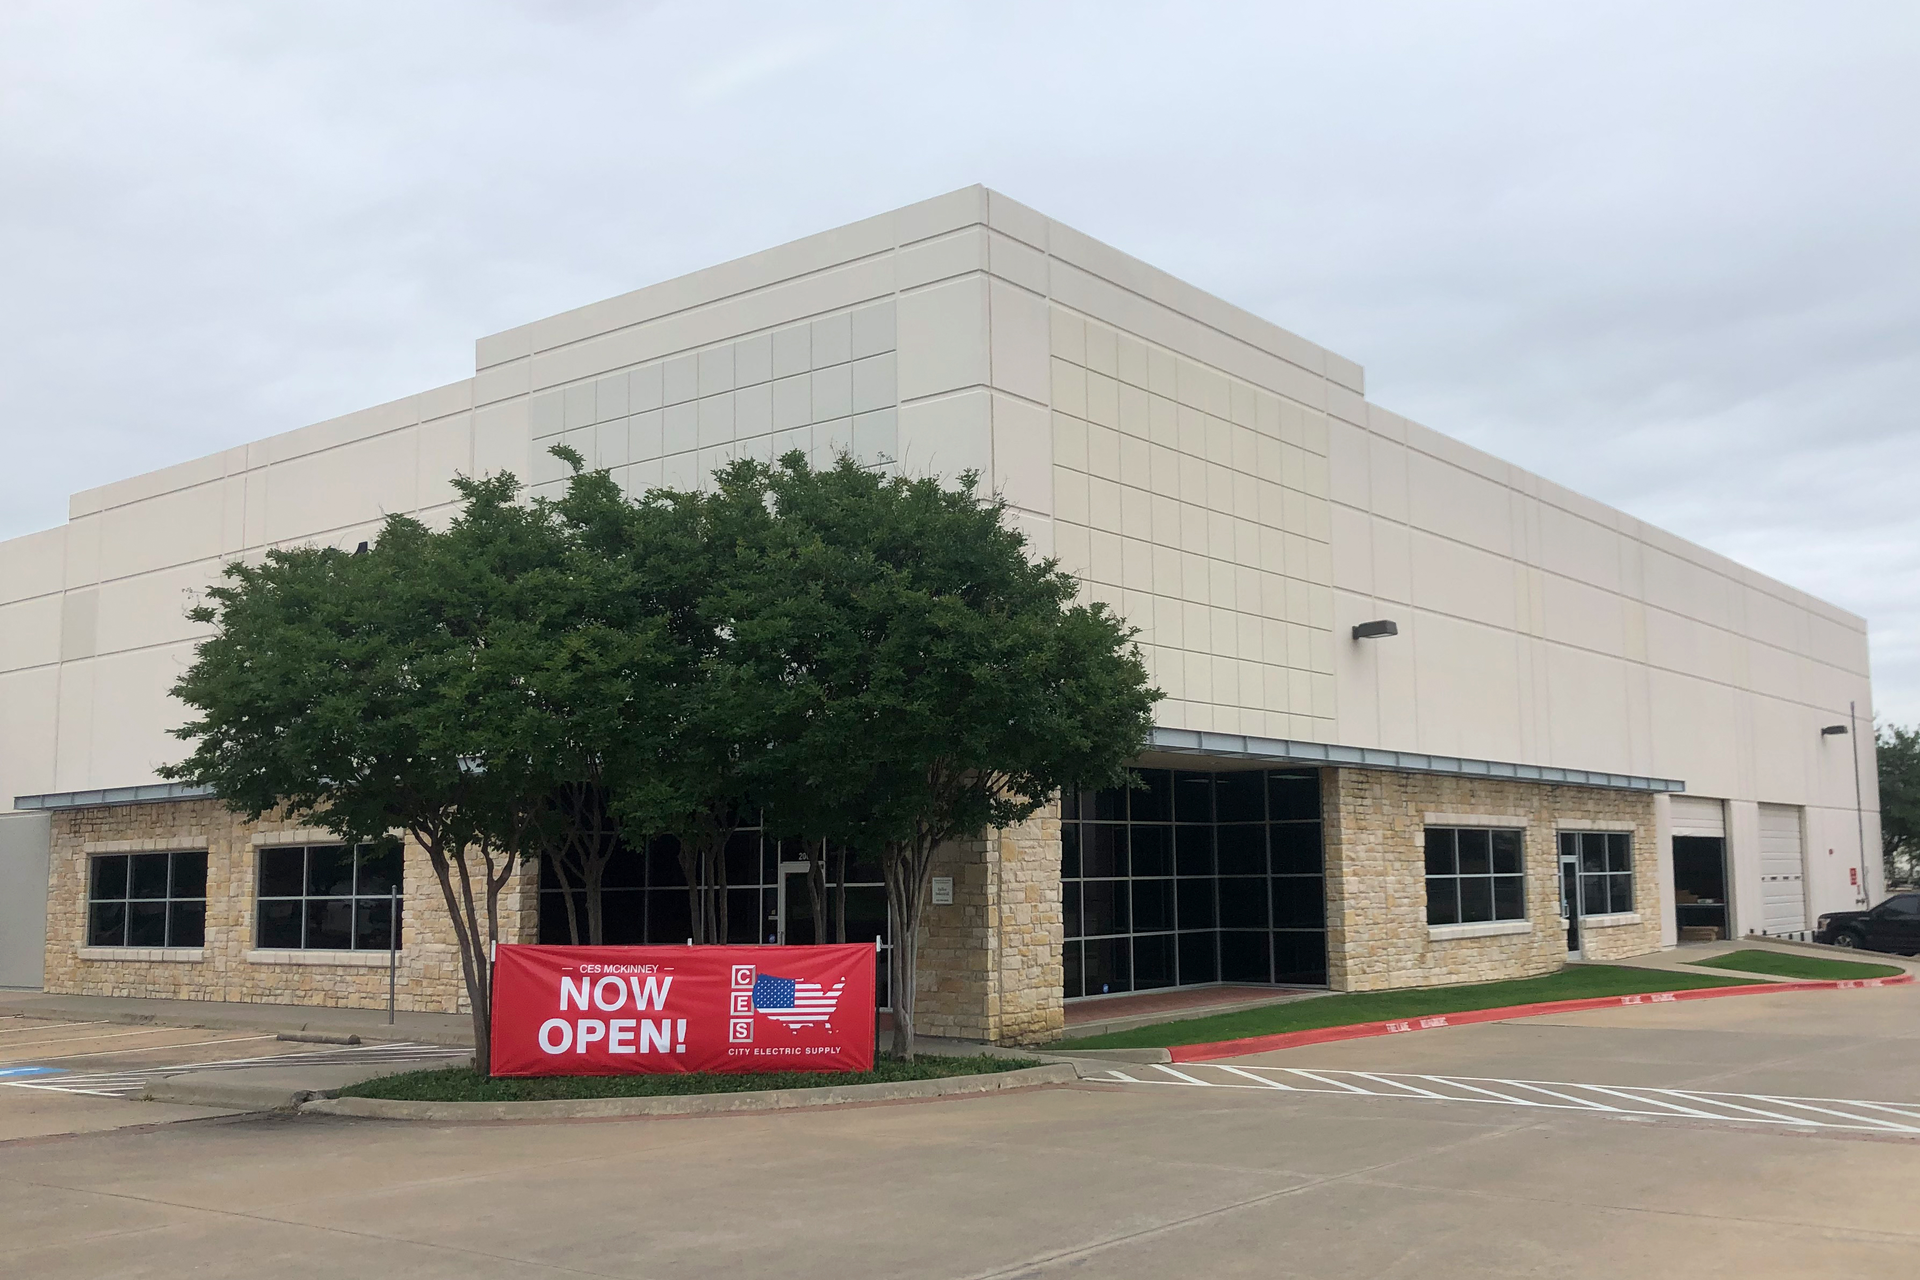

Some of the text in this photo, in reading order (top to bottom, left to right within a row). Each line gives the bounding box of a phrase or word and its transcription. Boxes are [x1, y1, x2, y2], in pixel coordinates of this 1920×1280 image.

[579, 964, 659, 973] CES MCKINNEY
[559, 975, 673, 1012] NOW
[735, 969, 751, 1038] CES
[538, 1018, 687, 1055] OPEN!
[728, 1046, 841, 1056] CITY ELECTRIC SUPPLY
